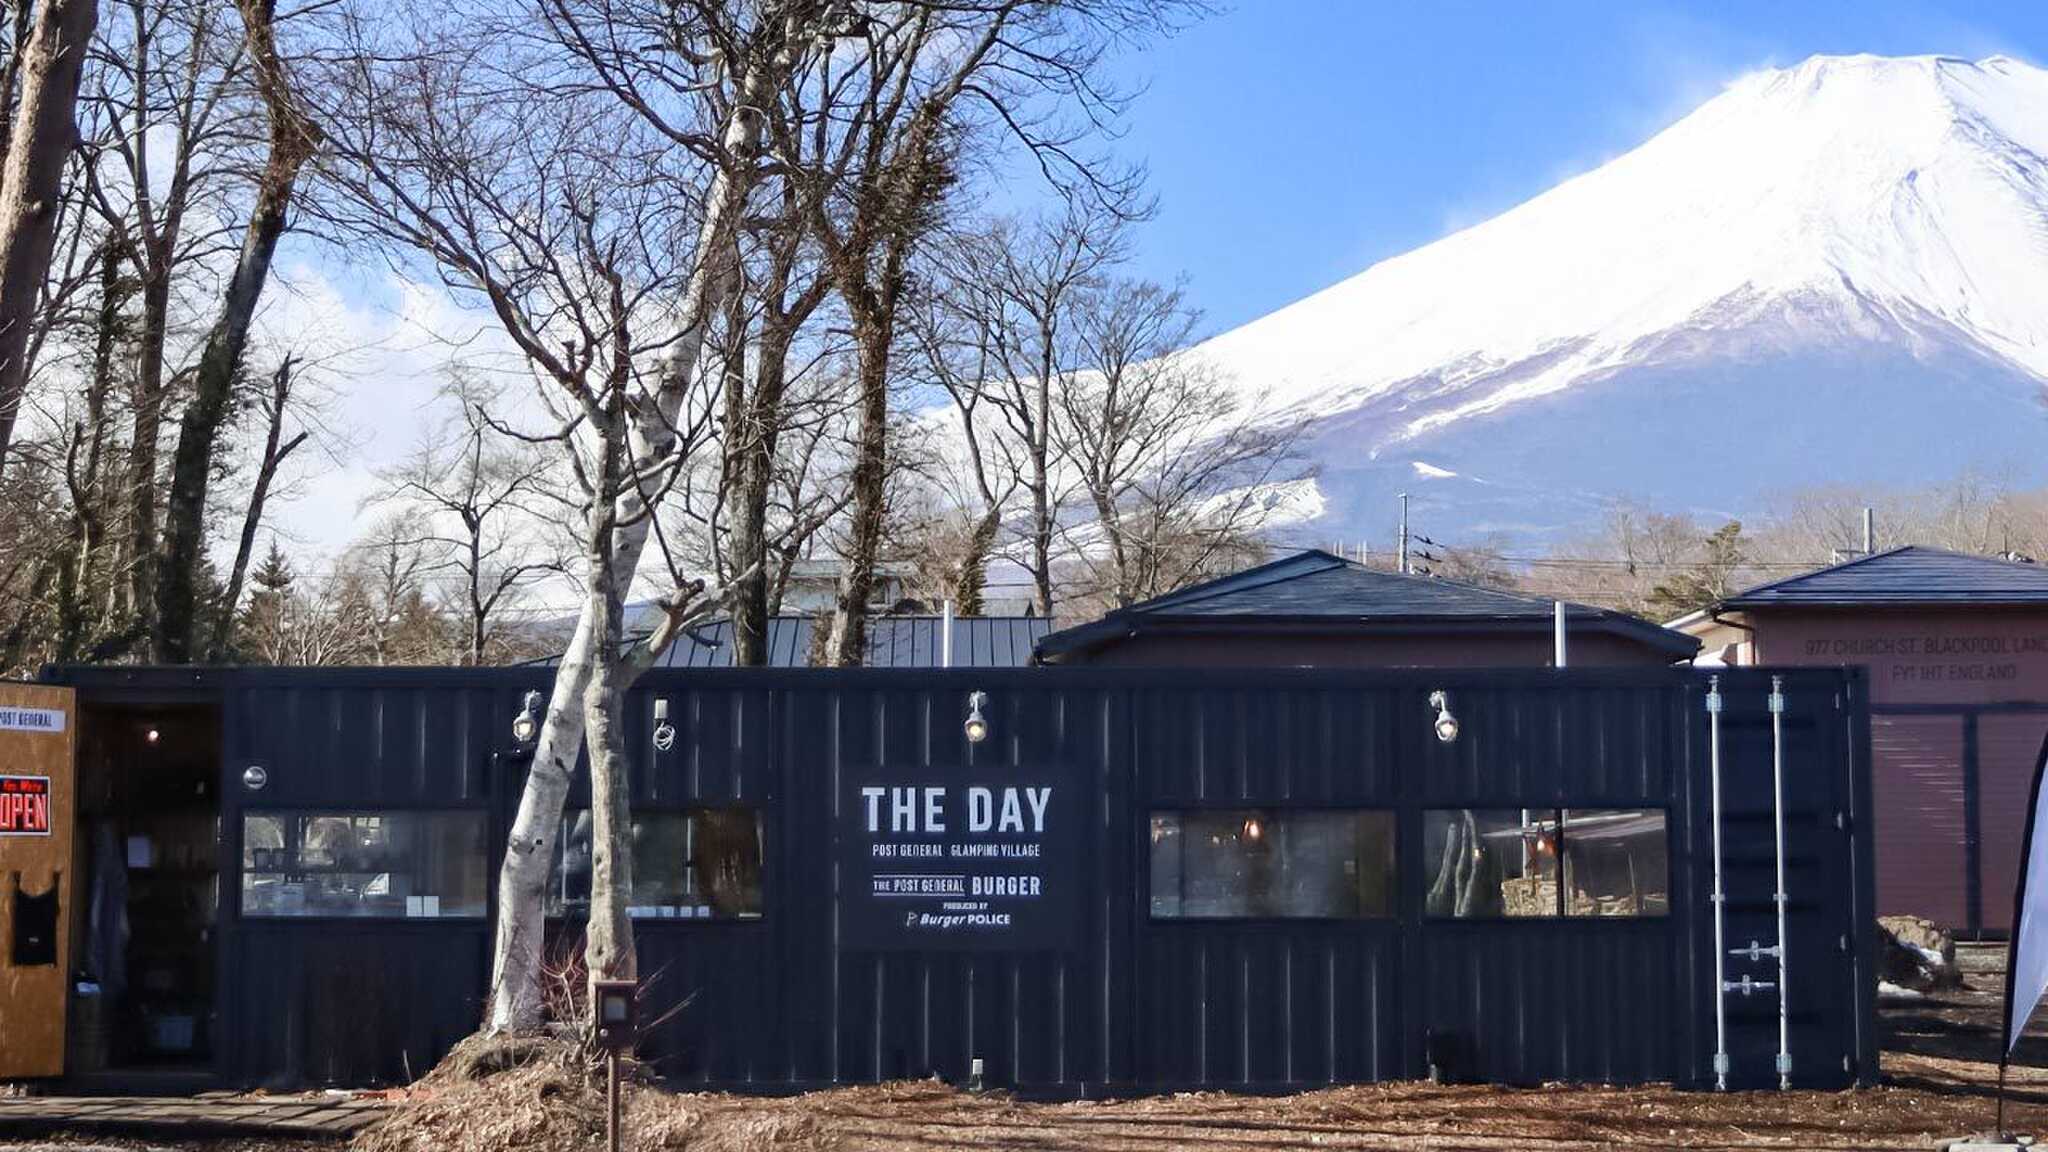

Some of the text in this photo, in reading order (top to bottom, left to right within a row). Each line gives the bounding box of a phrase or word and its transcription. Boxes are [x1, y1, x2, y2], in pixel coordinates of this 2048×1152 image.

[1925, 637, 2010, 654] BLACKPOOL
[1949, 663, 2017, 680] ENGLAND
[0, 792, 47, 831] OPEN
[862, 787, 1051, 833] THE DAY
[872, 844, 1040, 857] POST GENERAL GLAMPING VILLAGE
[873, 876, 1041, 895] THE POST GENERAL BURGER
